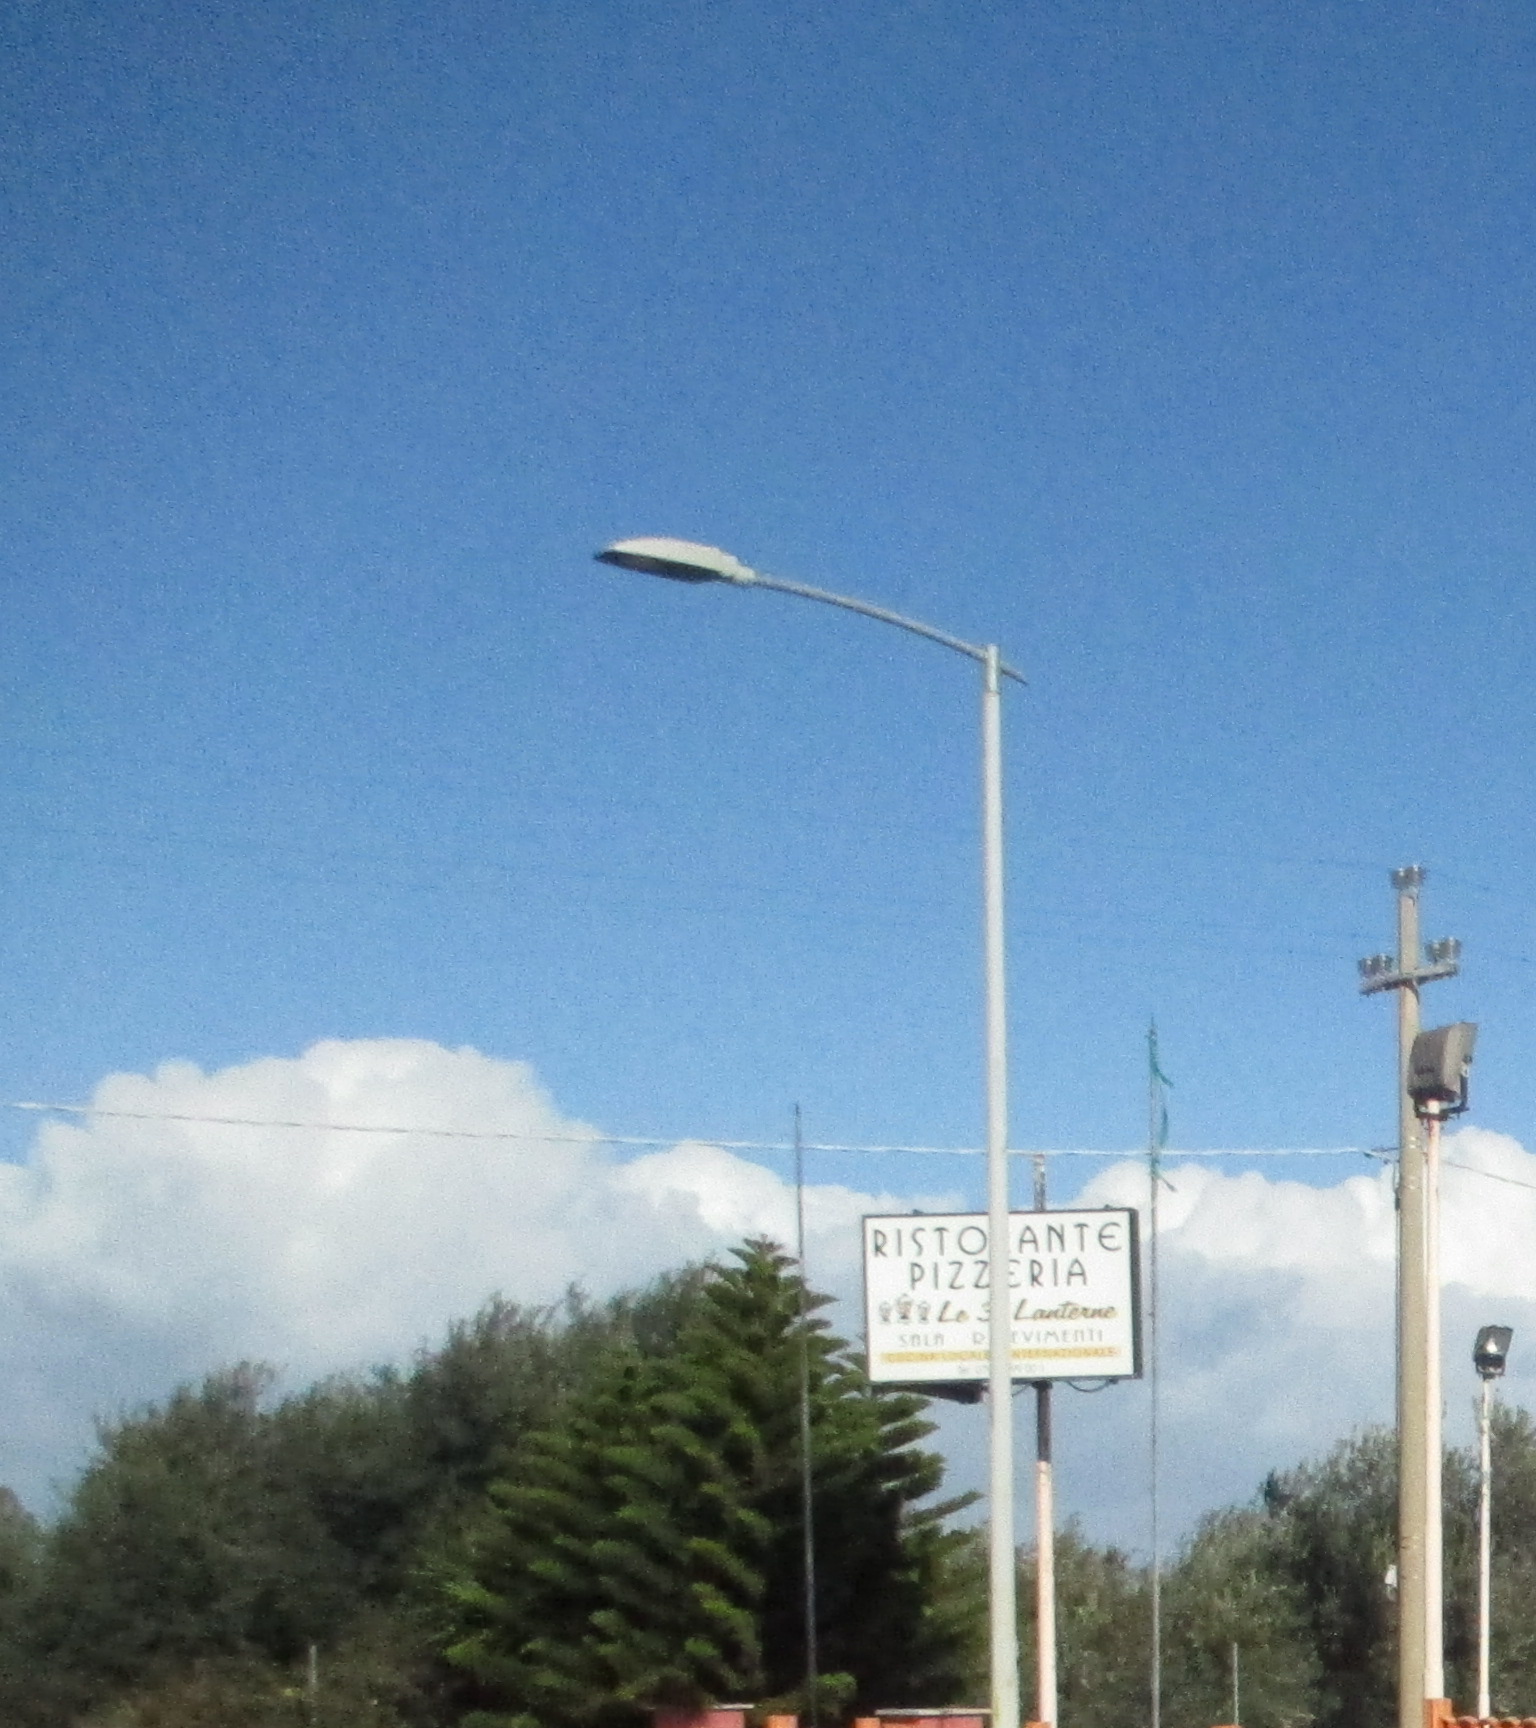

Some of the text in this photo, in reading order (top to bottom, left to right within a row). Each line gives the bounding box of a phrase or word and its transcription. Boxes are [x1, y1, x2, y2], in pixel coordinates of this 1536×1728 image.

[874, 1222, 1121, 1257] RISTOANTE
[910, 1258, 1087, 1290] PIZZERIA
[937, 1300, 970, 1322] Le
[1014, 1298, 1118, 1321] Lanterne
[972, 1328, 1104, 1347] REVIMENTI
